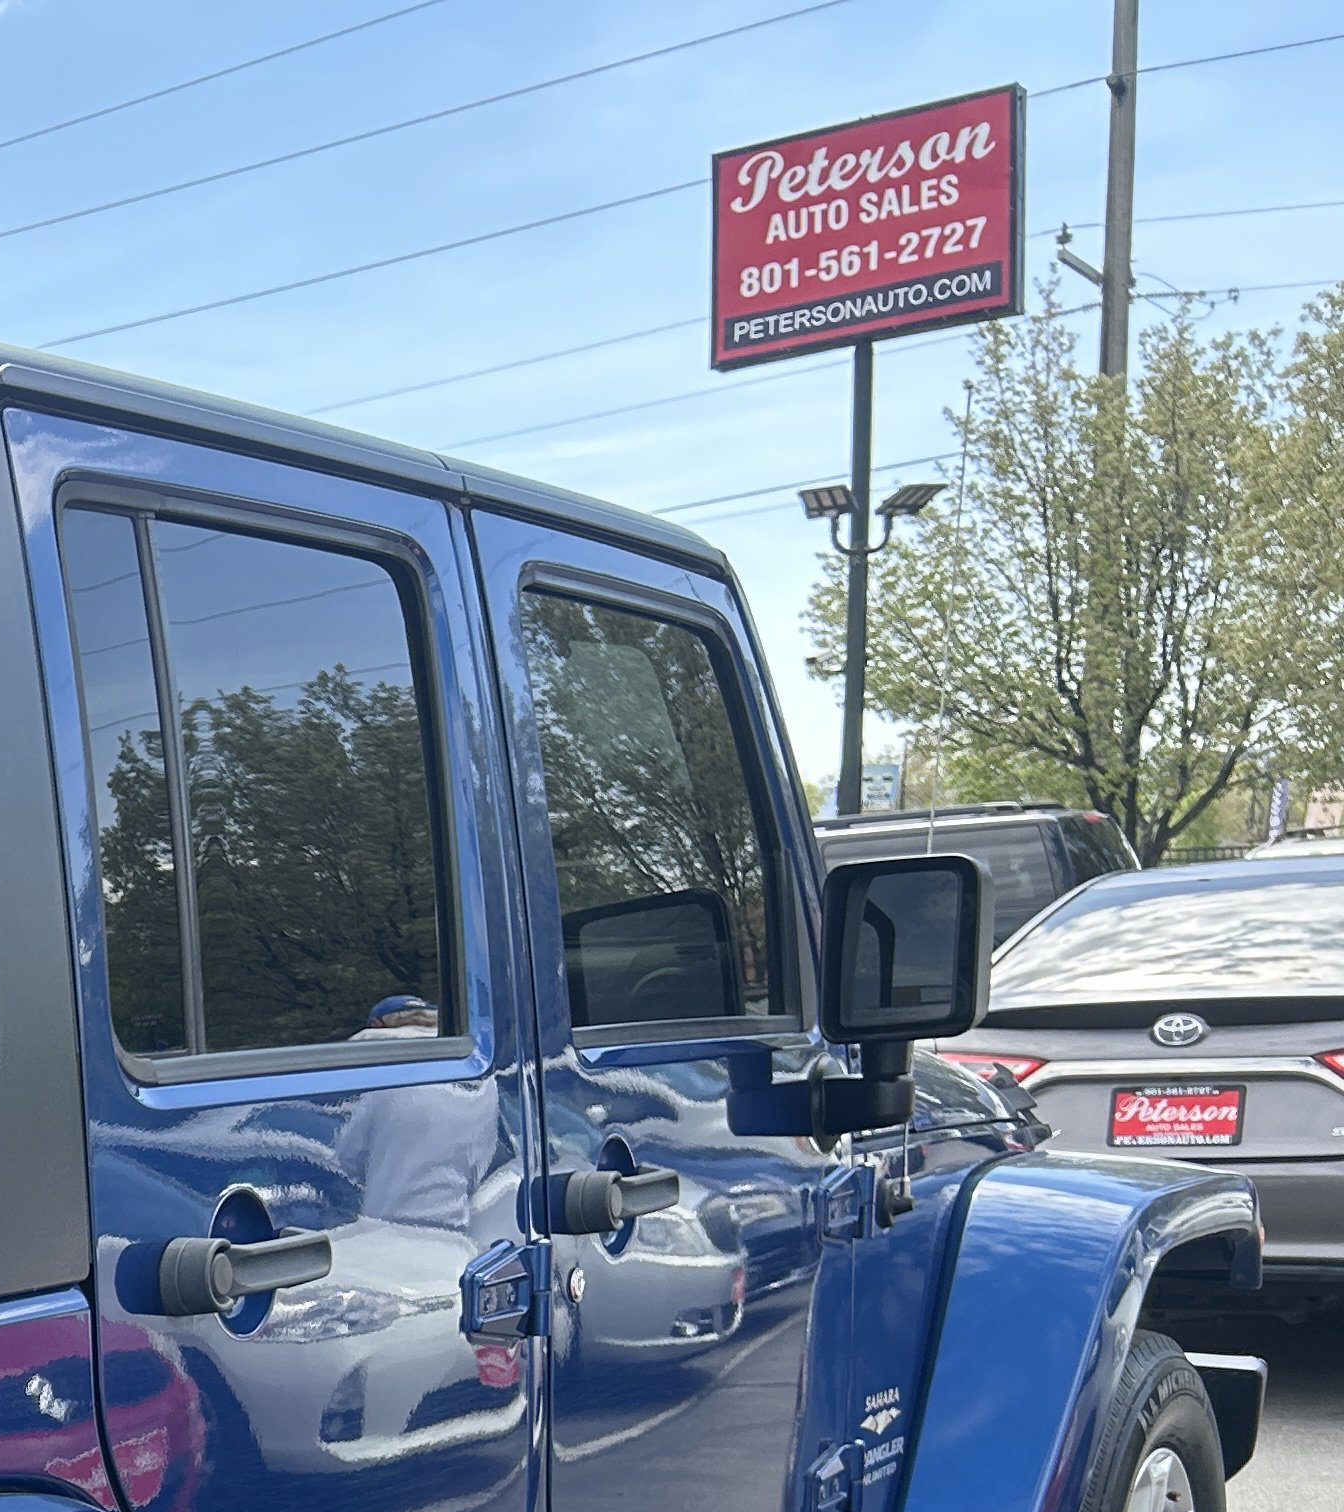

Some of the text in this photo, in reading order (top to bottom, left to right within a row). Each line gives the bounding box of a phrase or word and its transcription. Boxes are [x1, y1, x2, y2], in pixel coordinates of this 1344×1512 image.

[730, 121, 996, 214] Peterson
[765, 173, 960, 245] AUTO SALES
[739, 216, 988, 299] 801-561-2727
[733, 269, 992, 343] PETERSONAUTO.COM
[1114, 1096, 1238, 1123] Peterson
[864, 1387, 900, 1413] SAHARA
[863, 1461, 897, 1486] NLIMITED
[864, 1436, 905, 1468] ANGLER
